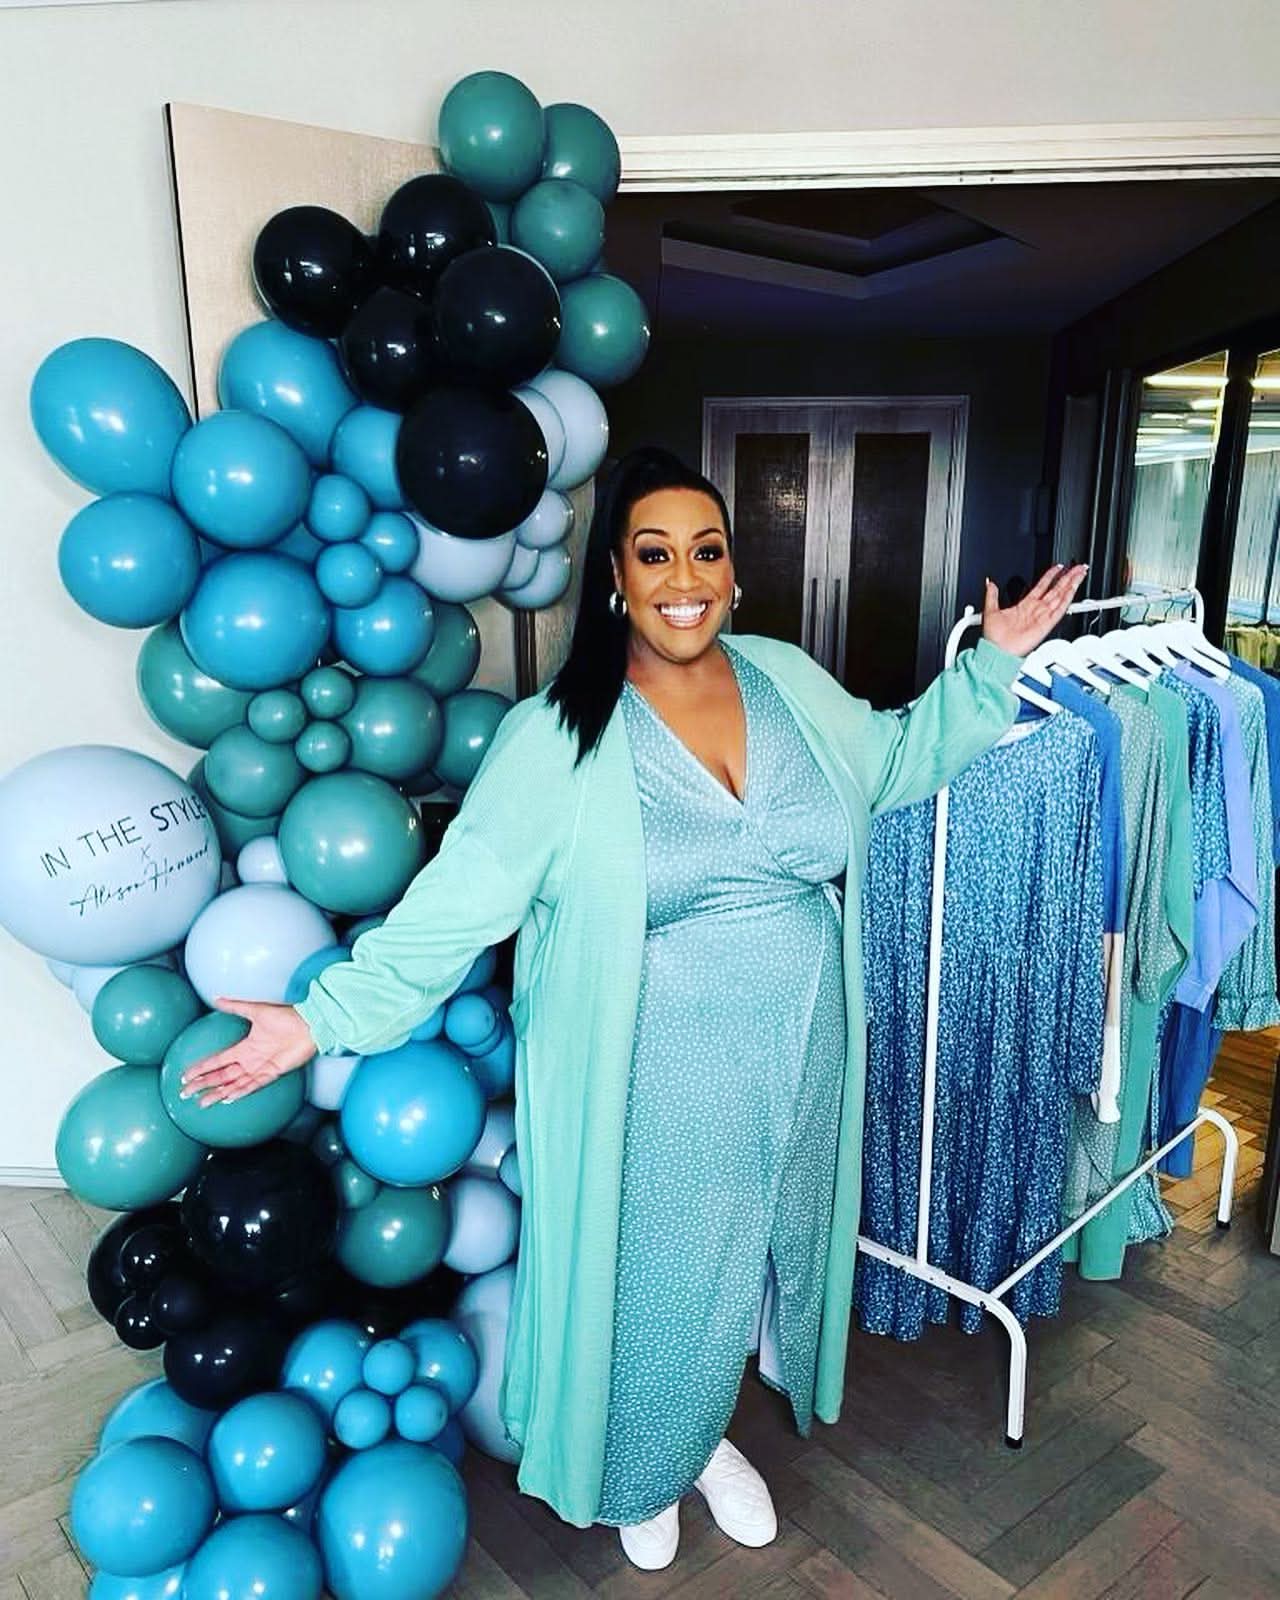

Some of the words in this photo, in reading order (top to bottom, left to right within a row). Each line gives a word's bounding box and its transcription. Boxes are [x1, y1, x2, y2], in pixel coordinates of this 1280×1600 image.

[40, 846, 71, 878] IN
[77, 816, 143, 856] THE
[150, 794, 207, 832] STYLE
